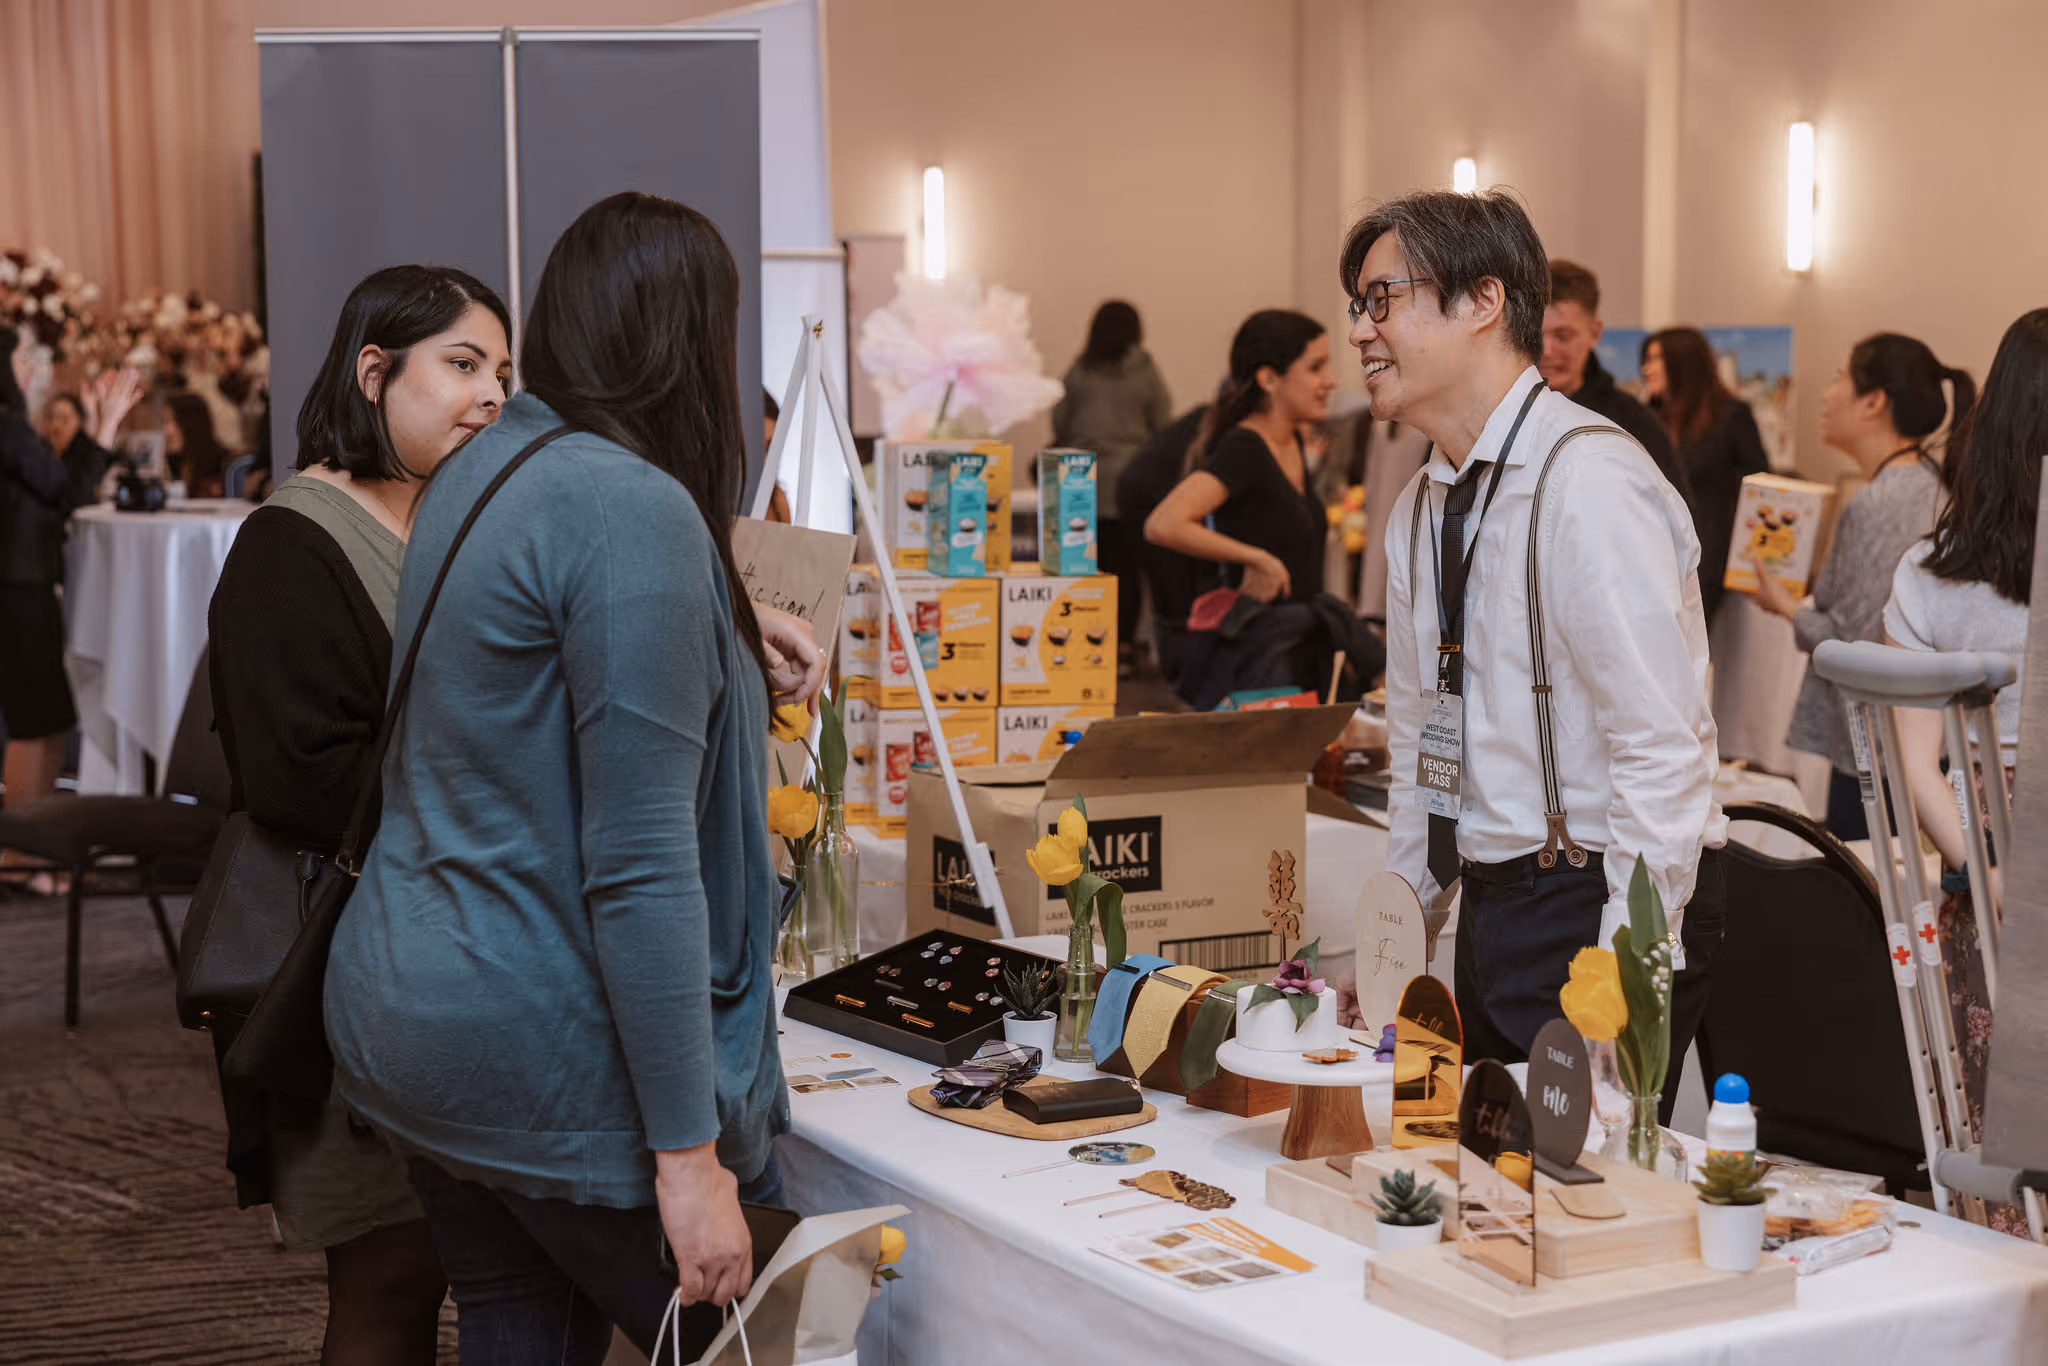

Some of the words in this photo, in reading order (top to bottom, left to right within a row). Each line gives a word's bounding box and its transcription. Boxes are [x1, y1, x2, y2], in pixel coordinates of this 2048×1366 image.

[1008, 586, 1053, 602] LAIKI
[1059, 601, 1072, 617] 3
[941, 642, 956, 660] 3
[1004, 715, 1048, 731] LAIKI
[1425, 723, 1439, 733] WEST
[1439, 726, 1456, 736] COAST
[1420, 731, 1445, 743] WEDDING
[1444, 736, 1460, 747] SHOW
[1422, 757, 1458, 777] VENDOR
[1428, 772, 1450, 788] PASS
[1088, 832, 1150, 866] AIKI
[1379, 911, 1403, 925] TABLE
[1546, 1046, 1574, 1069] TABLE
